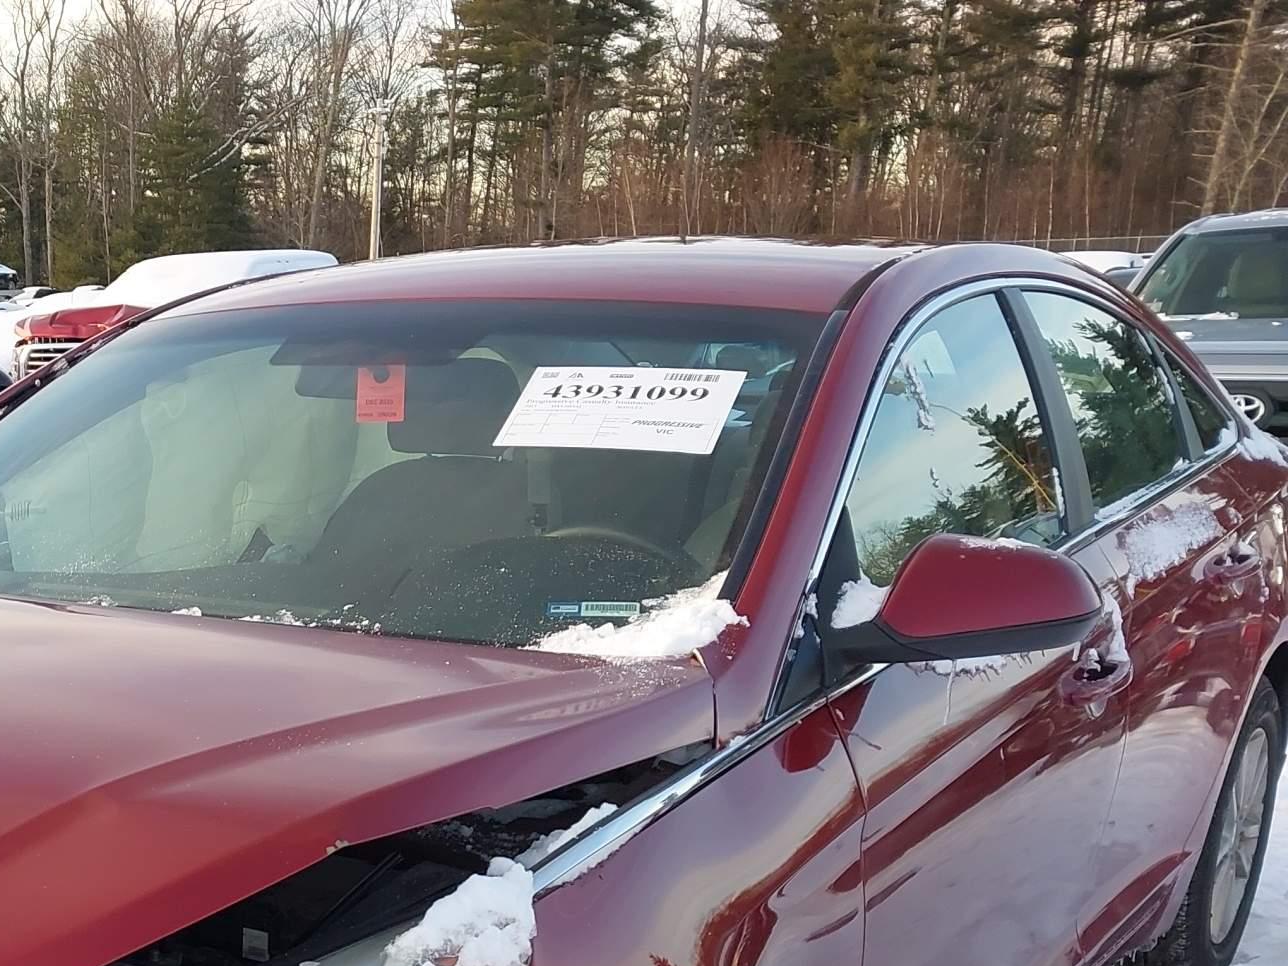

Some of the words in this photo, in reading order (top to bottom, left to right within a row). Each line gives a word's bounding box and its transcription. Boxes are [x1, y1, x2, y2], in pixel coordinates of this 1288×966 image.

[544, 384, 710, 401] 43931099
[631, 420, 705, 429] PROGRESSIVE
[655, 428, 675, 436] VIC
